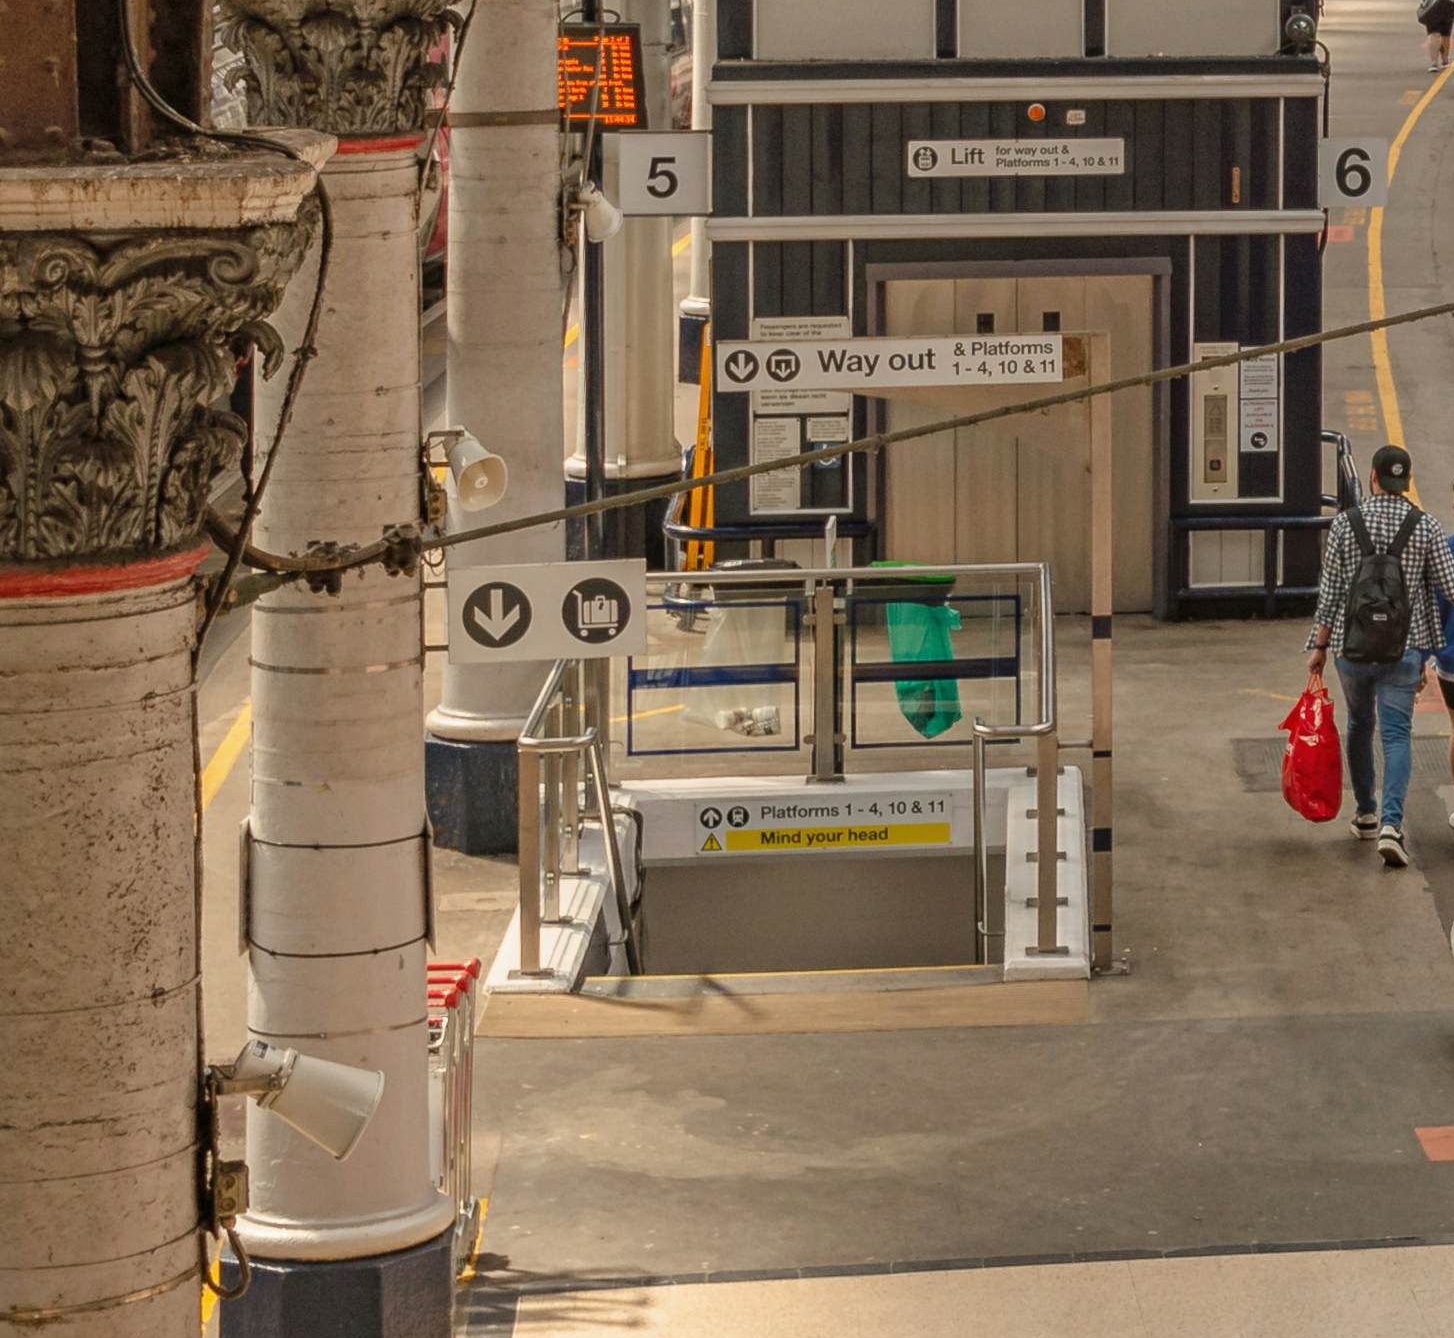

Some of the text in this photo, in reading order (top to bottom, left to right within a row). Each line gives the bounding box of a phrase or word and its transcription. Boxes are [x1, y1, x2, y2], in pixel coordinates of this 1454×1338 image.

[951, 148, 985, 164] Lift
[996, 146, 1069, 156] for way out &
[646, 156, 678, 199] 5
[1335, 152, 1372, 198] 6
[954, 341, 1053, 356] & Platforms
[818, 349, 936, 377] Way out
[953, 363, 959, 375] 1
[998, 361, 1017, 374] 10
[1024, 360, 1035, 373] &
[1040, 360, 1055, 373] 11
[761, 805, 839, 820] Platforms
[845, 804, 851, 816] 1
[890, 802, 906, 815] 10
[911, 801, 922, 813] &
[928, 800, 944, 813] 11
[760, 828, 888, 846] Mind your head
